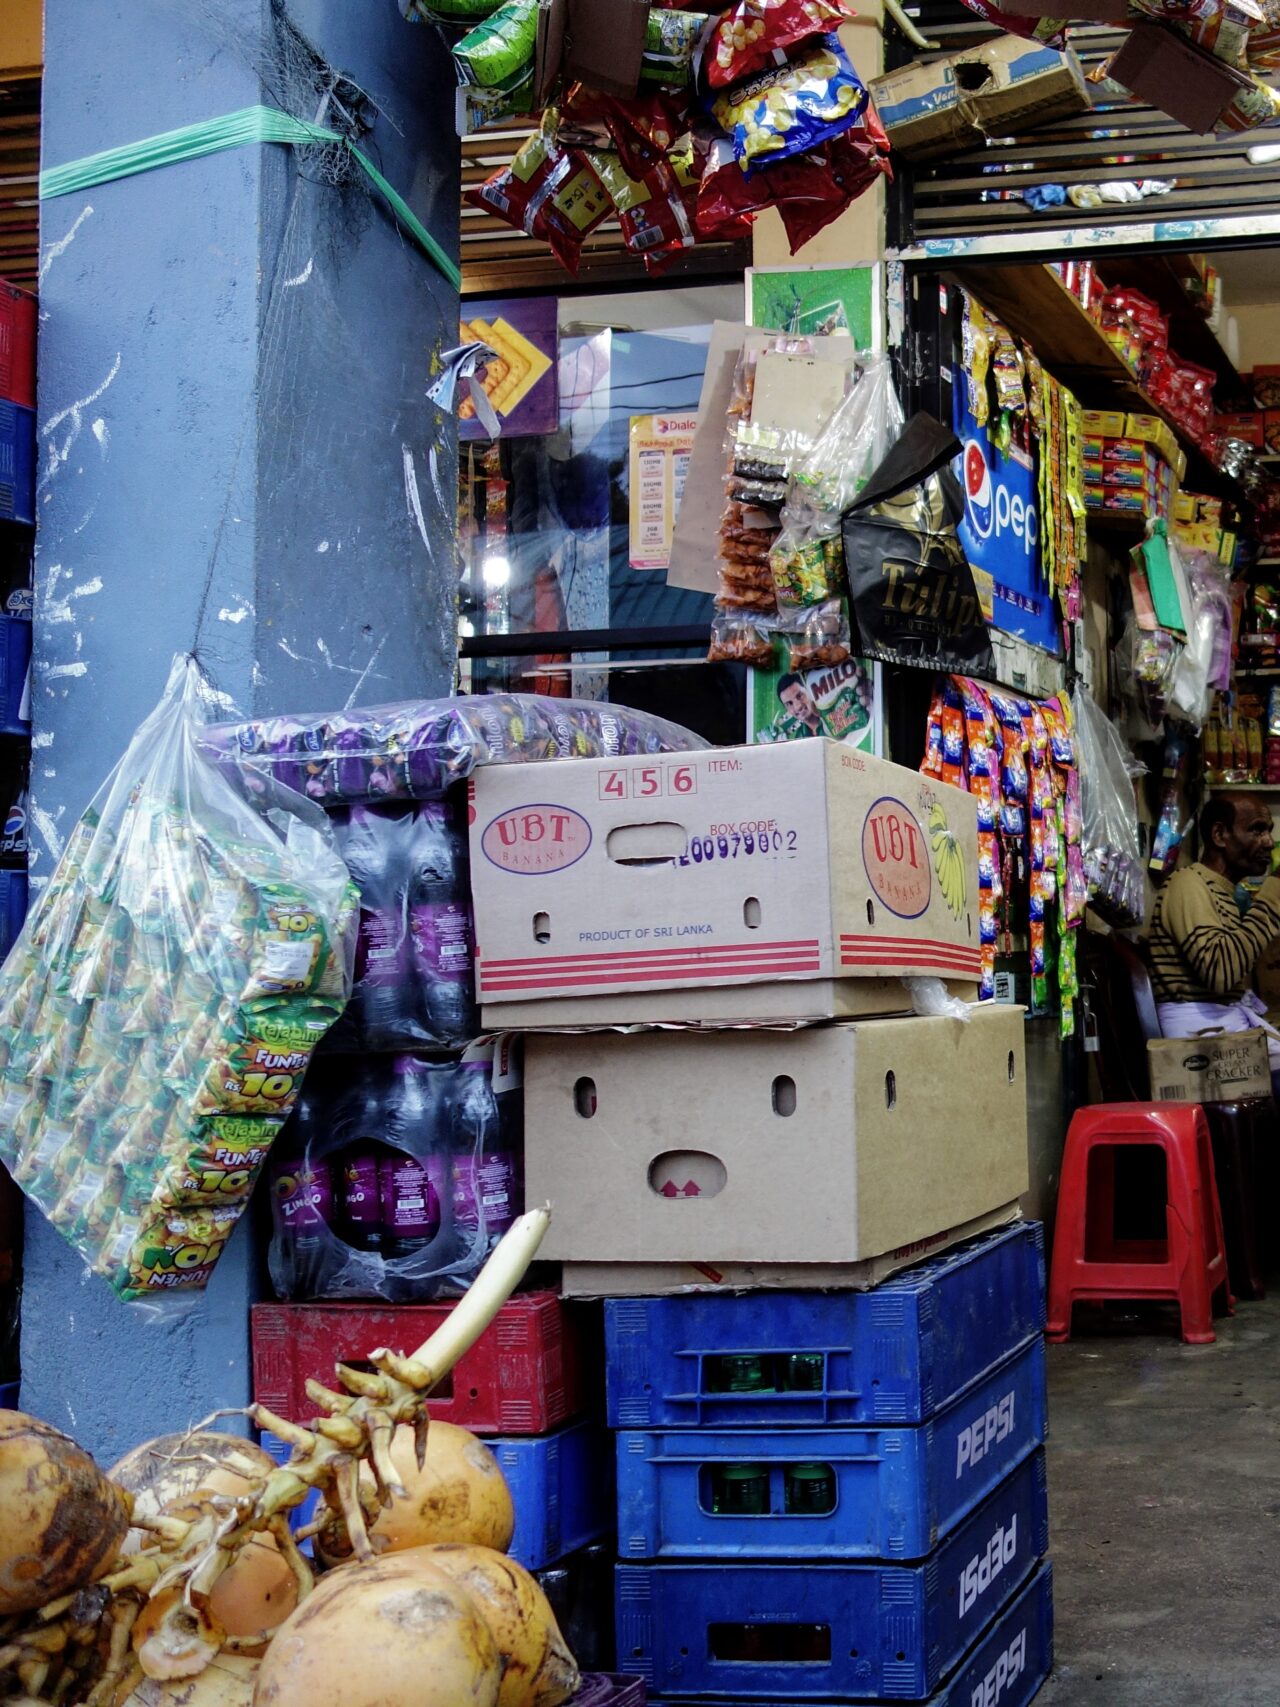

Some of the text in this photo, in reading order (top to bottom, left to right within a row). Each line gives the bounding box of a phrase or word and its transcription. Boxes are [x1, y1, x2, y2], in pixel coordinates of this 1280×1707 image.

[811, 660, 857, 702] MILO
[708, 760, 742, 773] ITEM:
[604, 767, 693, 797] 4 5 6
[496, 813, 570, 847] UBT
[710, 822, 736, 837] BOX
[870, 815, 919, 870] UBT
[502, 849, 565, 866] BANANA
[878, 873, 923, 901] BANANA
[579, 924, 713, 942] PRODUCT OF SRI LANKA
[1212, 1047, 1250, 1062] SUPER
[1206, 1065, 1261, 1081] CRACKER
[281, 1193, 322, 1217] ZINGO
[956, 1390, 1016, 1480] PEPSI
[958, 1513, 1017, 1620] PEPSI
[970, 1627, 1027, 1707] PEPSI
